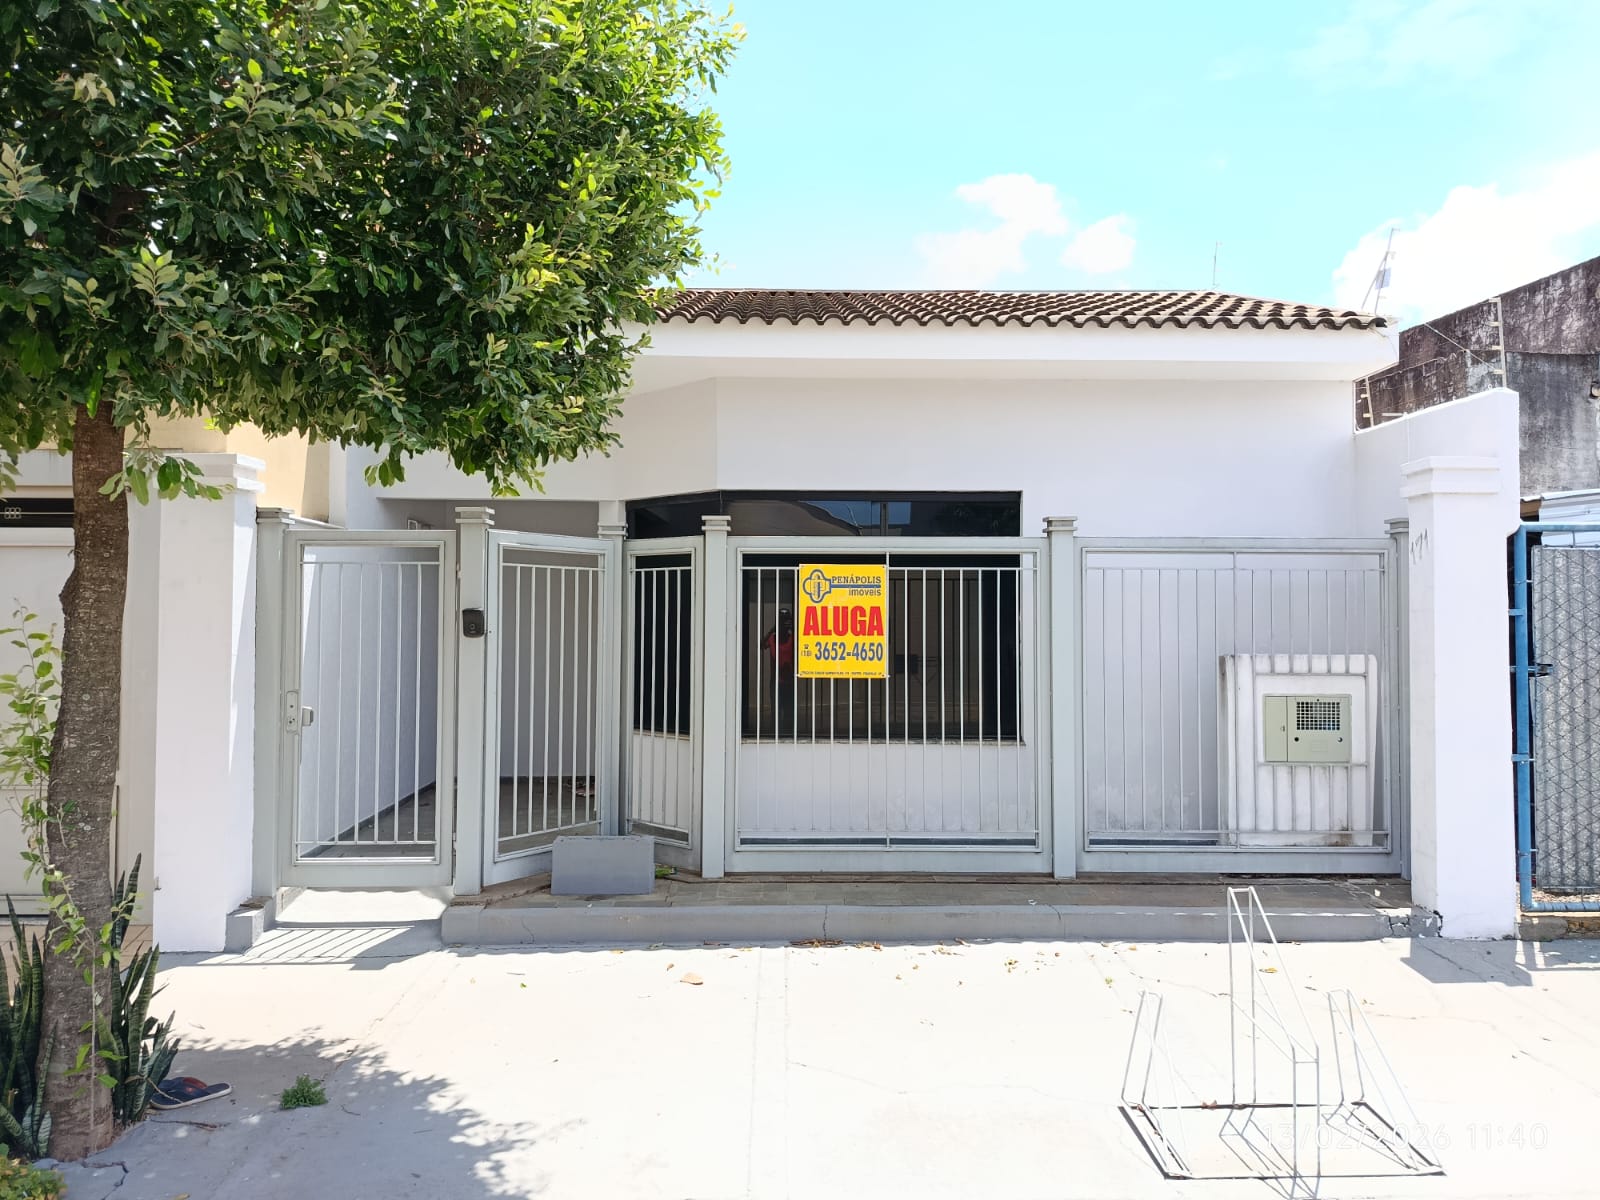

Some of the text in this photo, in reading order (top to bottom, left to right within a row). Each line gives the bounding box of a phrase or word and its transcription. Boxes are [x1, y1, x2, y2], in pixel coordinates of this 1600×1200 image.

[831, 574, 882, 584] PENÁPOLIS
[803, 606, 884, 637] ALUGA
[815, 641, 883, 661] 3652-4650
